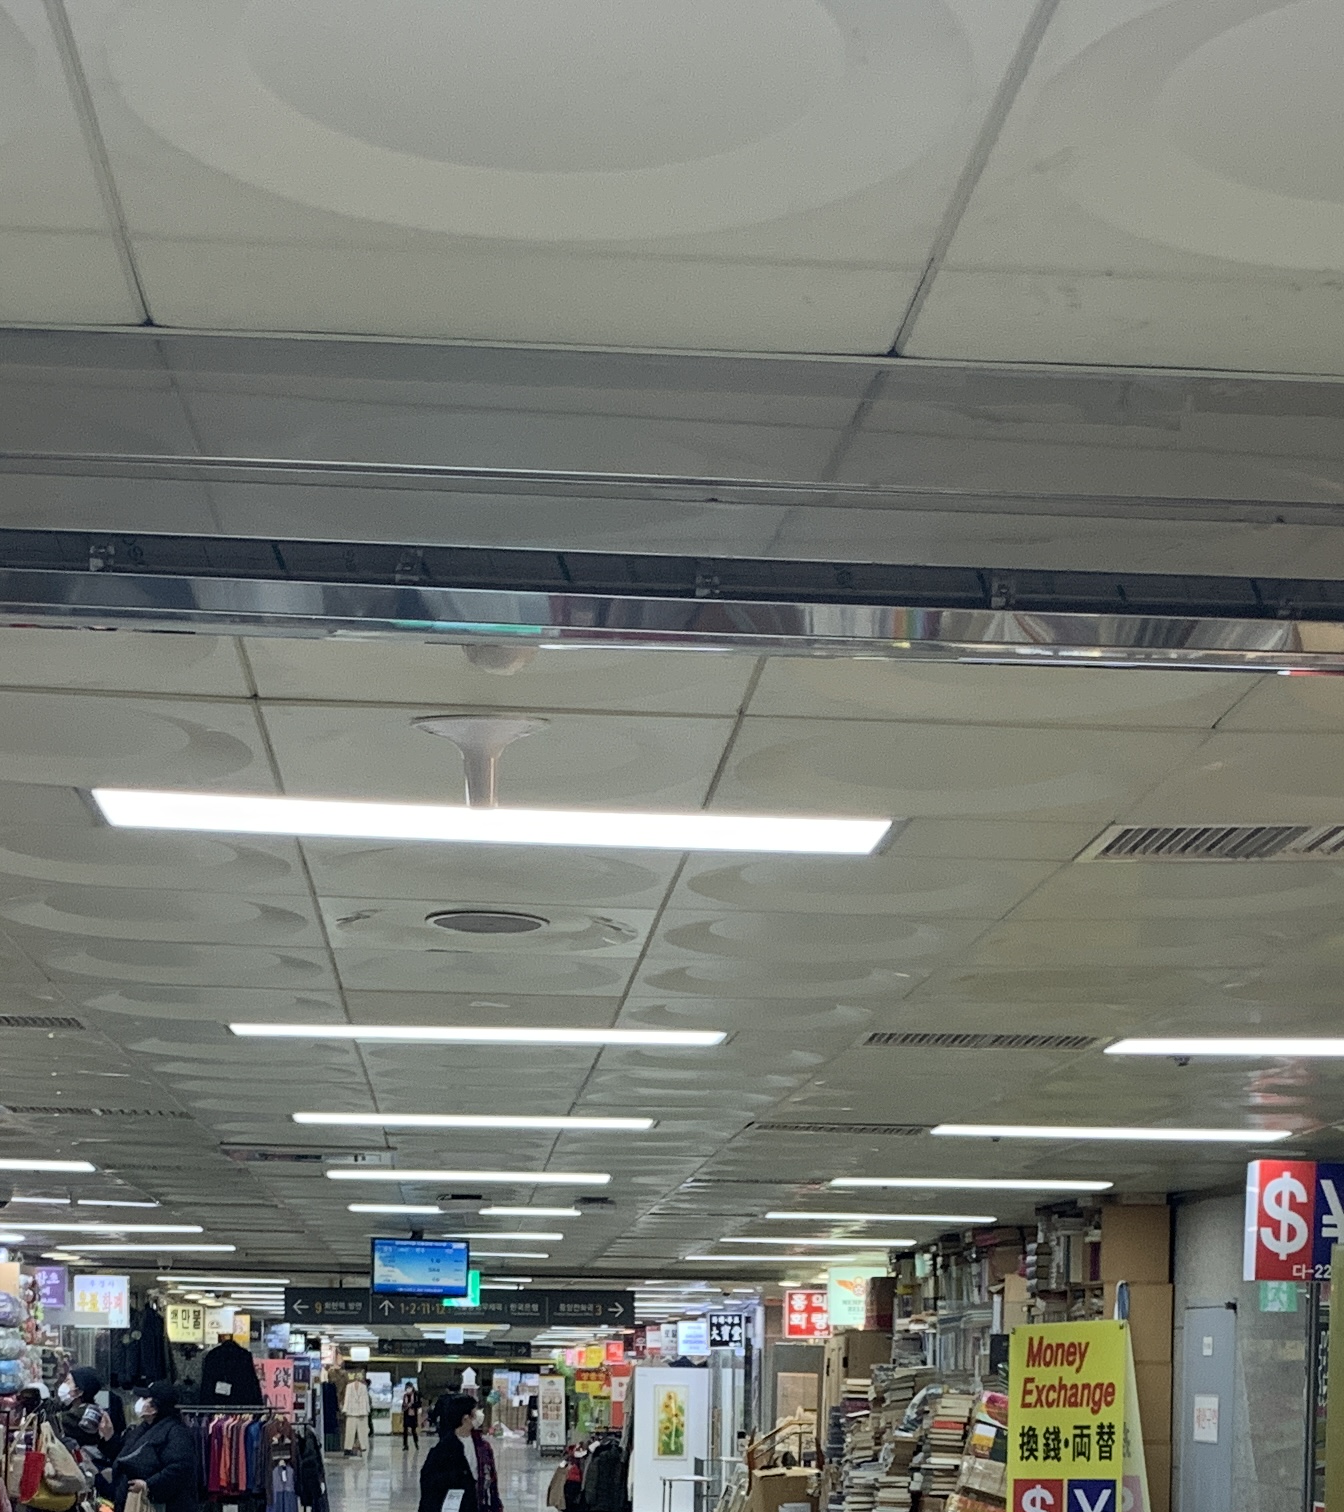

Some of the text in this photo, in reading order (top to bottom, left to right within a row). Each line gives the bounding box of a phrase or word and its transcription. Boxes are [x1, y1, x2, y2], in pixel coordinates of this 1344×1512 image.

[314, 1301, 323, 1314] 9
[594, 1304, 603, 1316] 3
[1026, 1336, 1090, 1374] Money
[1020, 1376, 1116, 1415] Exchange
